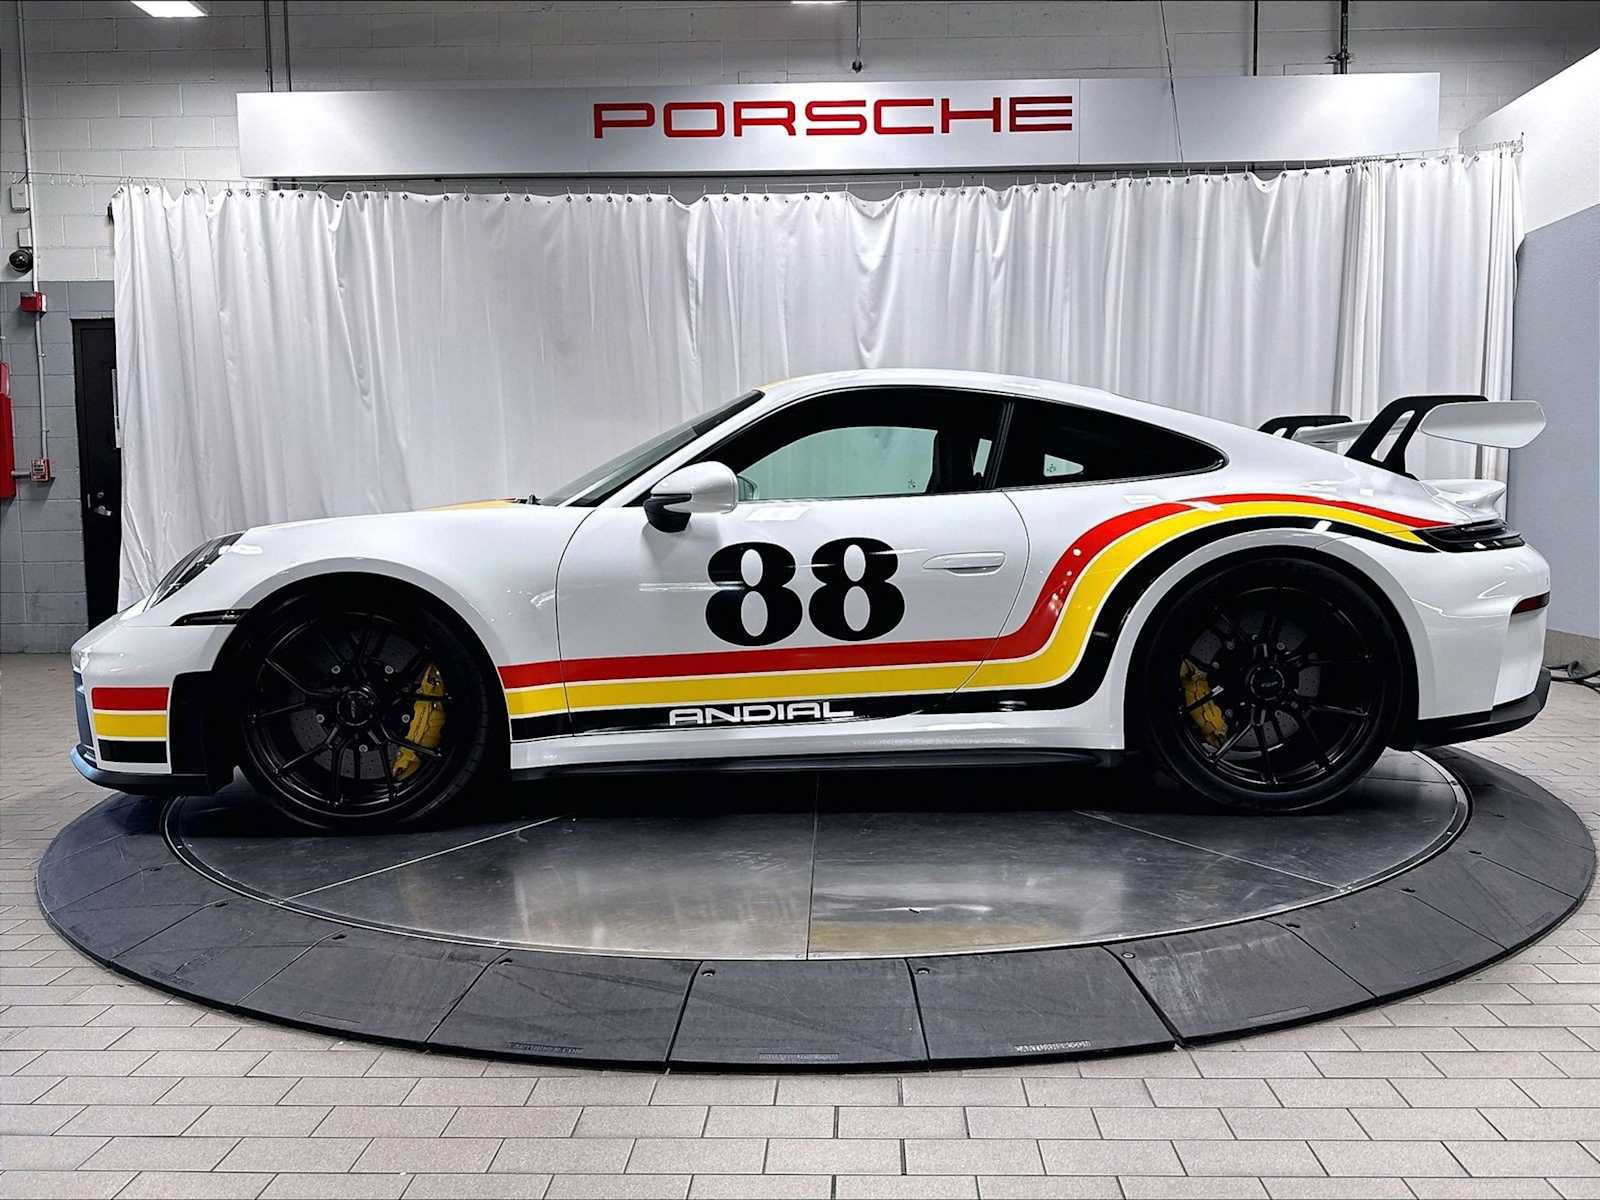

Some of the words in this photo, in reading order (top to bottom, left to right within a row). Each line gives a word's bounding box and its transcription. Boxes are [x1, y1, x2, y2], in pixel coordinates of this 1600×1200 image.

[593, 96, 1073, 139] PORSCHE
[705, 537, 905, 646] 88
[669, 701, 854, 726] ANDIAL
